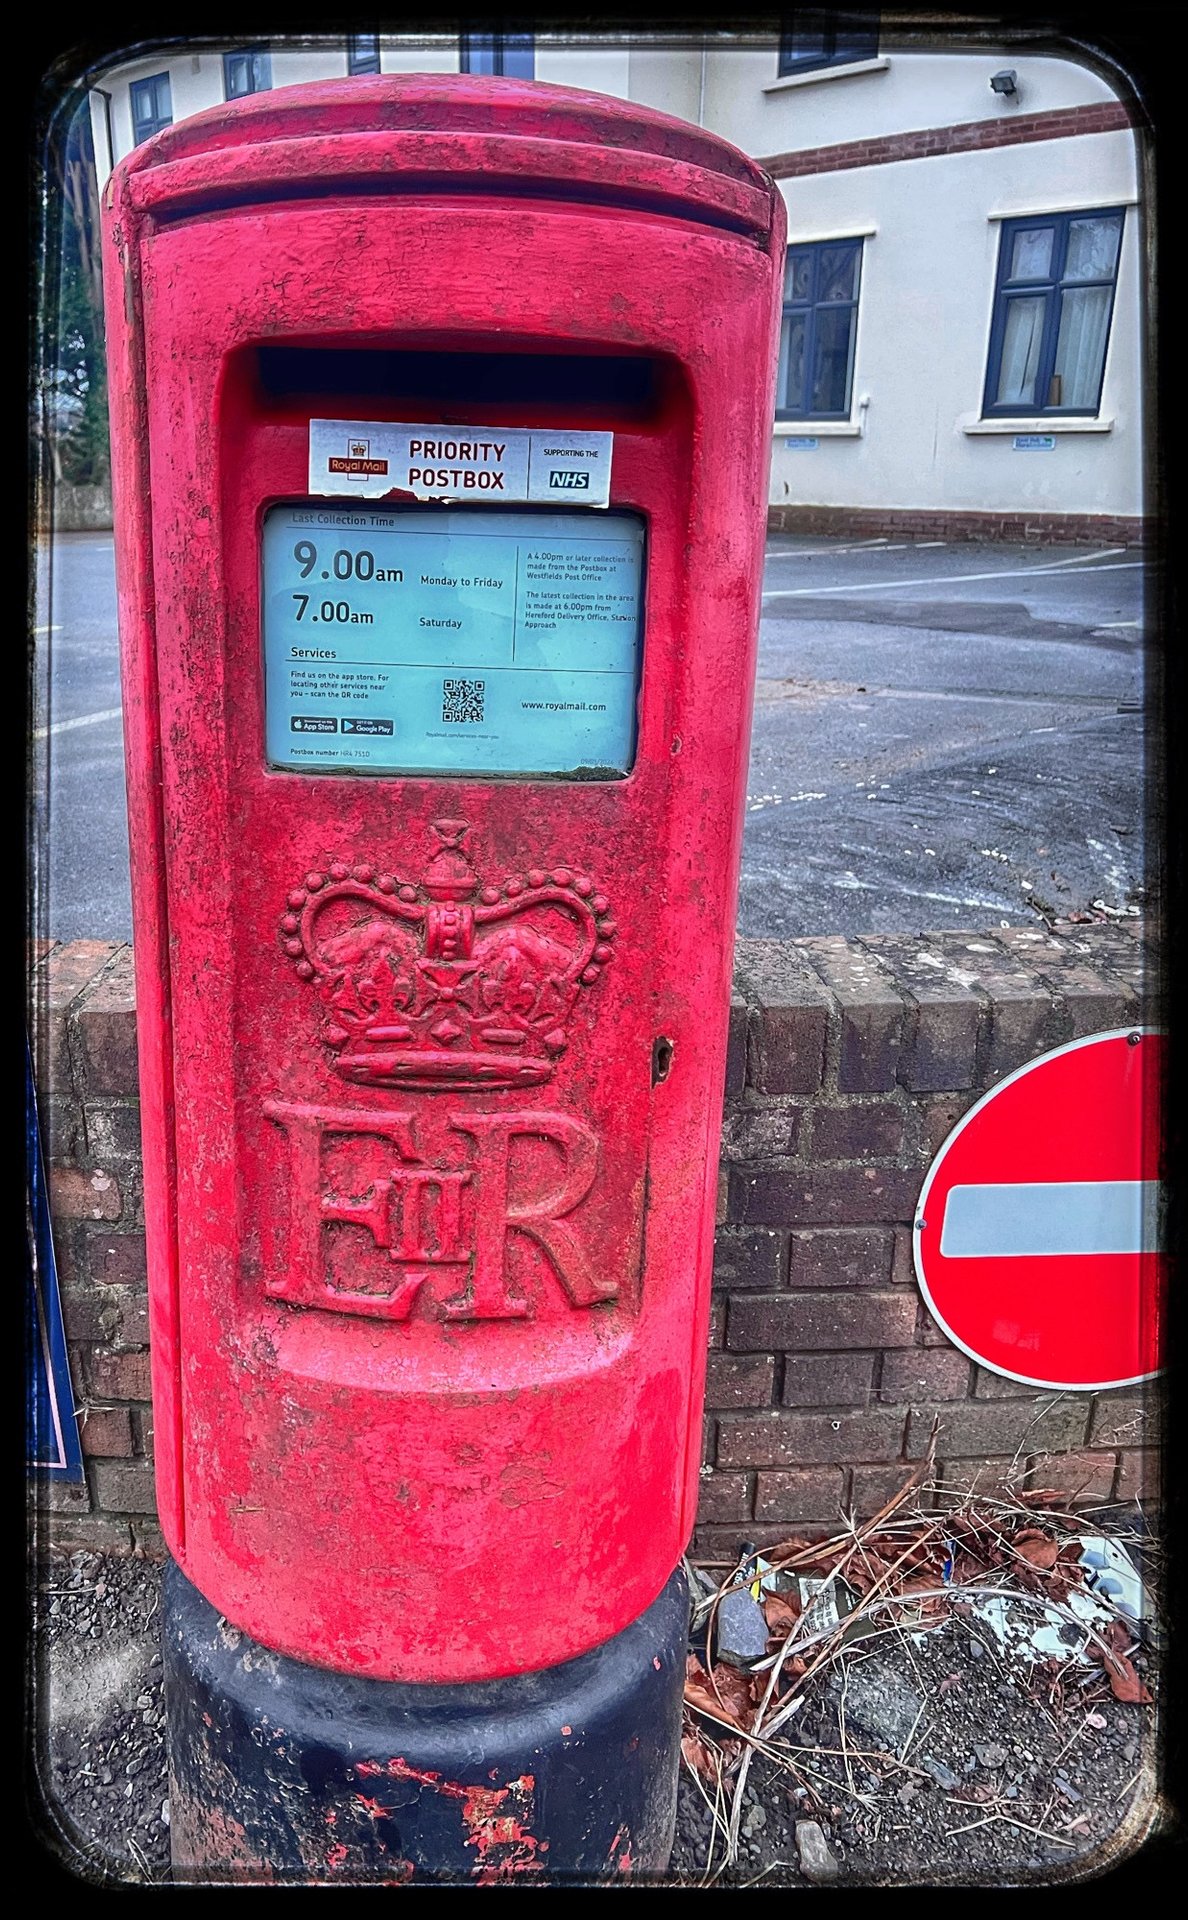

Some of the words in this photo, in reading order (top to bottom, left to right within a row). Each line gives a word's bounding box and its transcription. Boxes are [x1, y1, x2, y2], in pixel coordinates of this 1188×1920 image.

[410, 440, 506, 462] PRIORITY
[544, 448, 584, 458] SUPPORTING
[332, 460, 360, 472] Royal
[362, 461, 385, 472] Mail
[408, 468, 504, 490] POSTBOX
[550, 472, 588, 488] NHS
[292, 512, 314, 524] Last
[318, 514, 366, 526] Collection
[370, 516, 394, 526] Time
[294, 540, 403, 582] 9.00am
[534, 552, 564, 561] 4.00pm
[527, 572, 562, 580] Westfields
[420, 576, 458, 588] Monday
[461, 578, 470, 586] to
[474, 578, 503, 589] Friday
[292, 594, 374, 624] 7.00am
[564, 602, 592, 612] 6.00pm
[557, 612, 585, 620] Delivery
[420, 617, 462, 630] Saturday
[291, 646, 336, 658] Services
[290, 670, 306, 678] Find
[290, 680, 318, 689] locating
[522, 701, 606, 712] www.royalmail.com
[304, 723, 316, 731] App
[356, 725, 378, 733] Google
[378, 726, 390, 734] Play
